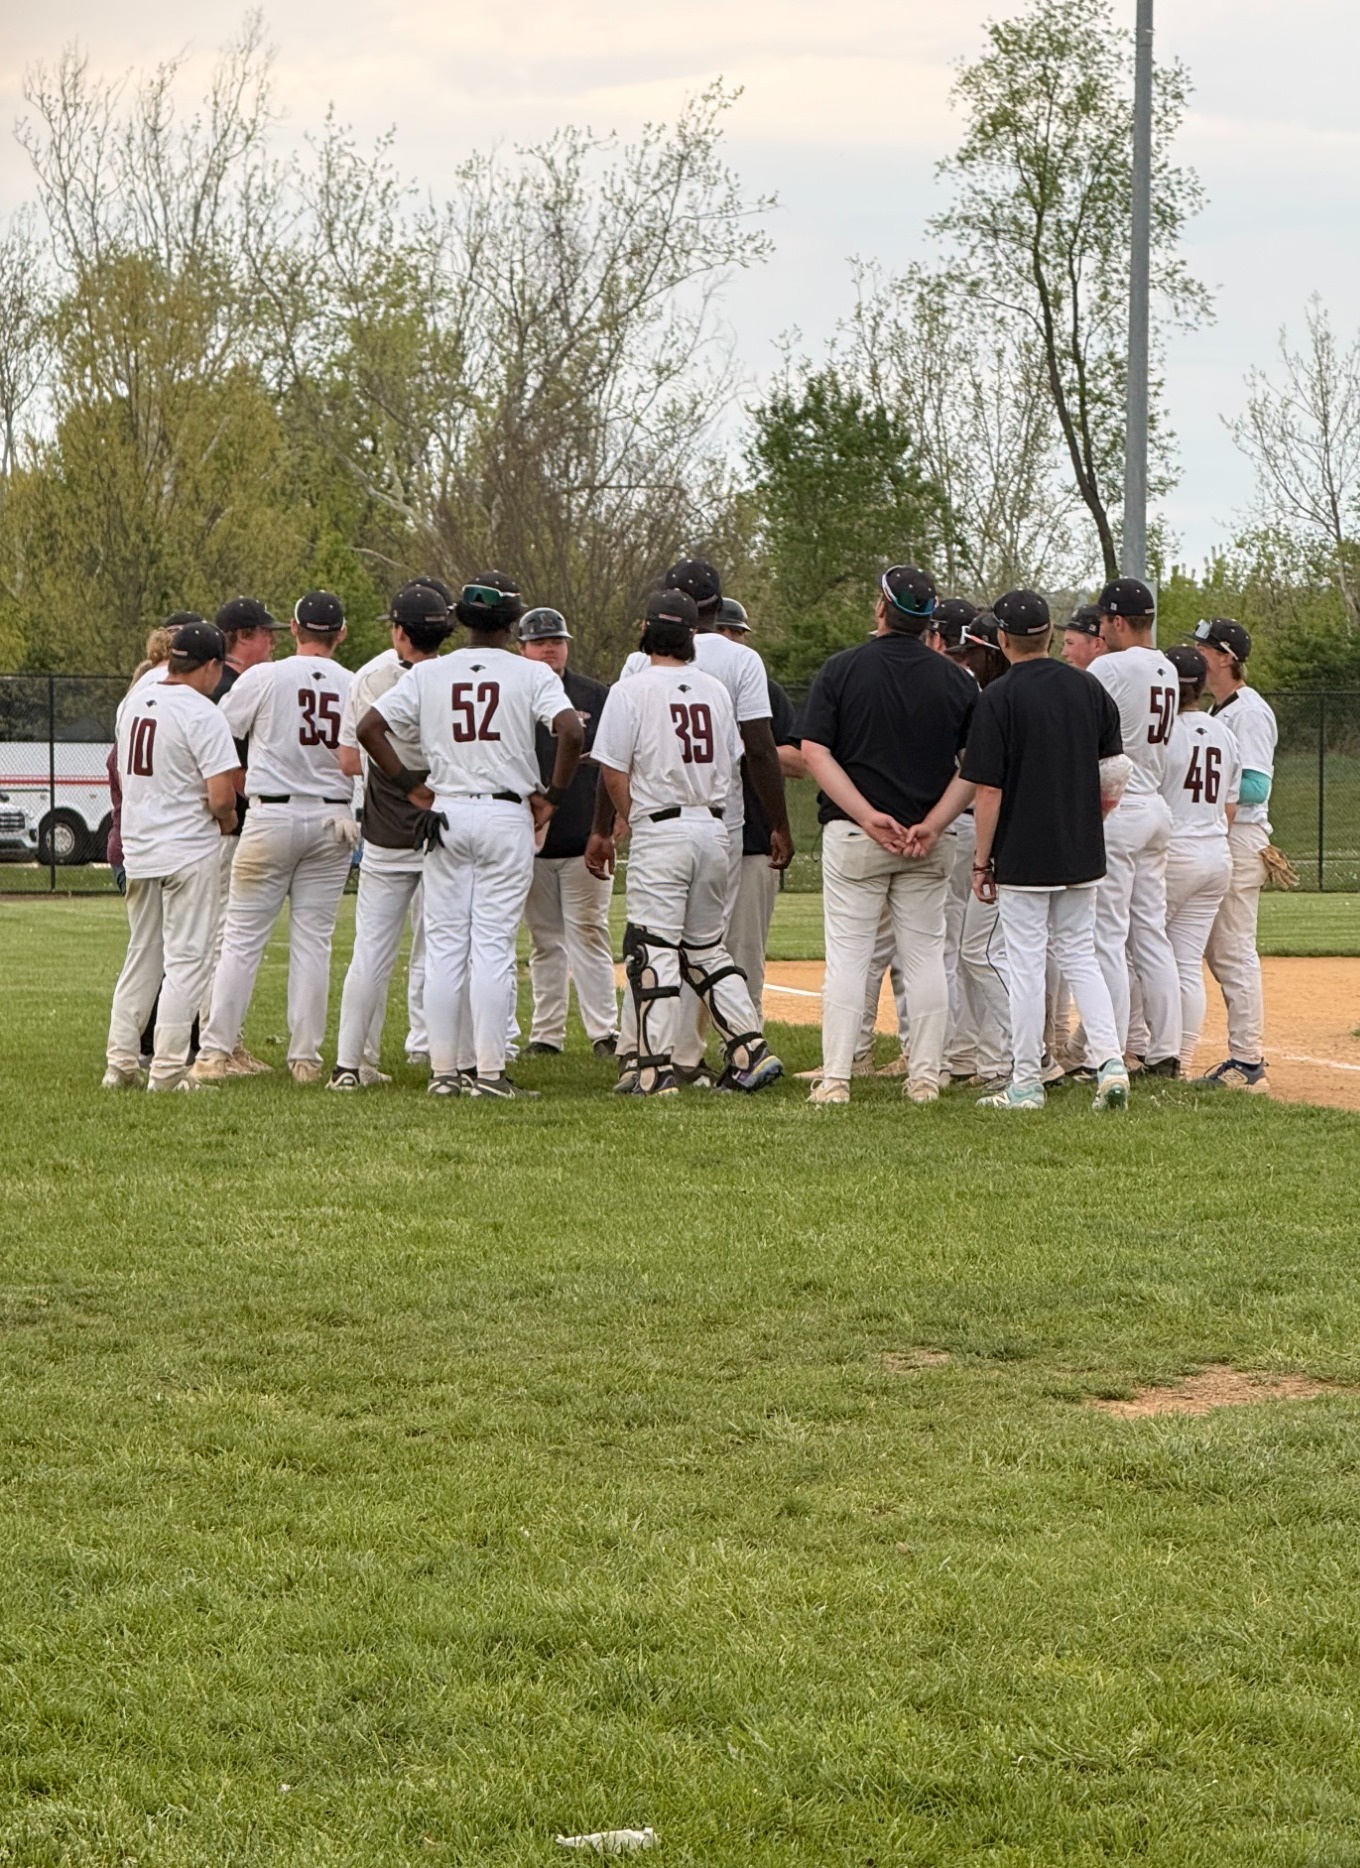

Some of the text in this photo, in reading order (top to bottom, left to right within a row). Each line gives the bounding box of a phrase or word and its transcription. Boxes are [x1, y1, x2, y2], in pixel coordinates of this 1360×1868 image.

[298, 689, 341, 750] 35
[451, 682, 501, 743] 52
[670, 703, 714, 764] 39
[1147, 686, 1177, 746] 50
[128, 717, 157, 777] 10
[1183, 745, 1223, 804] 46
